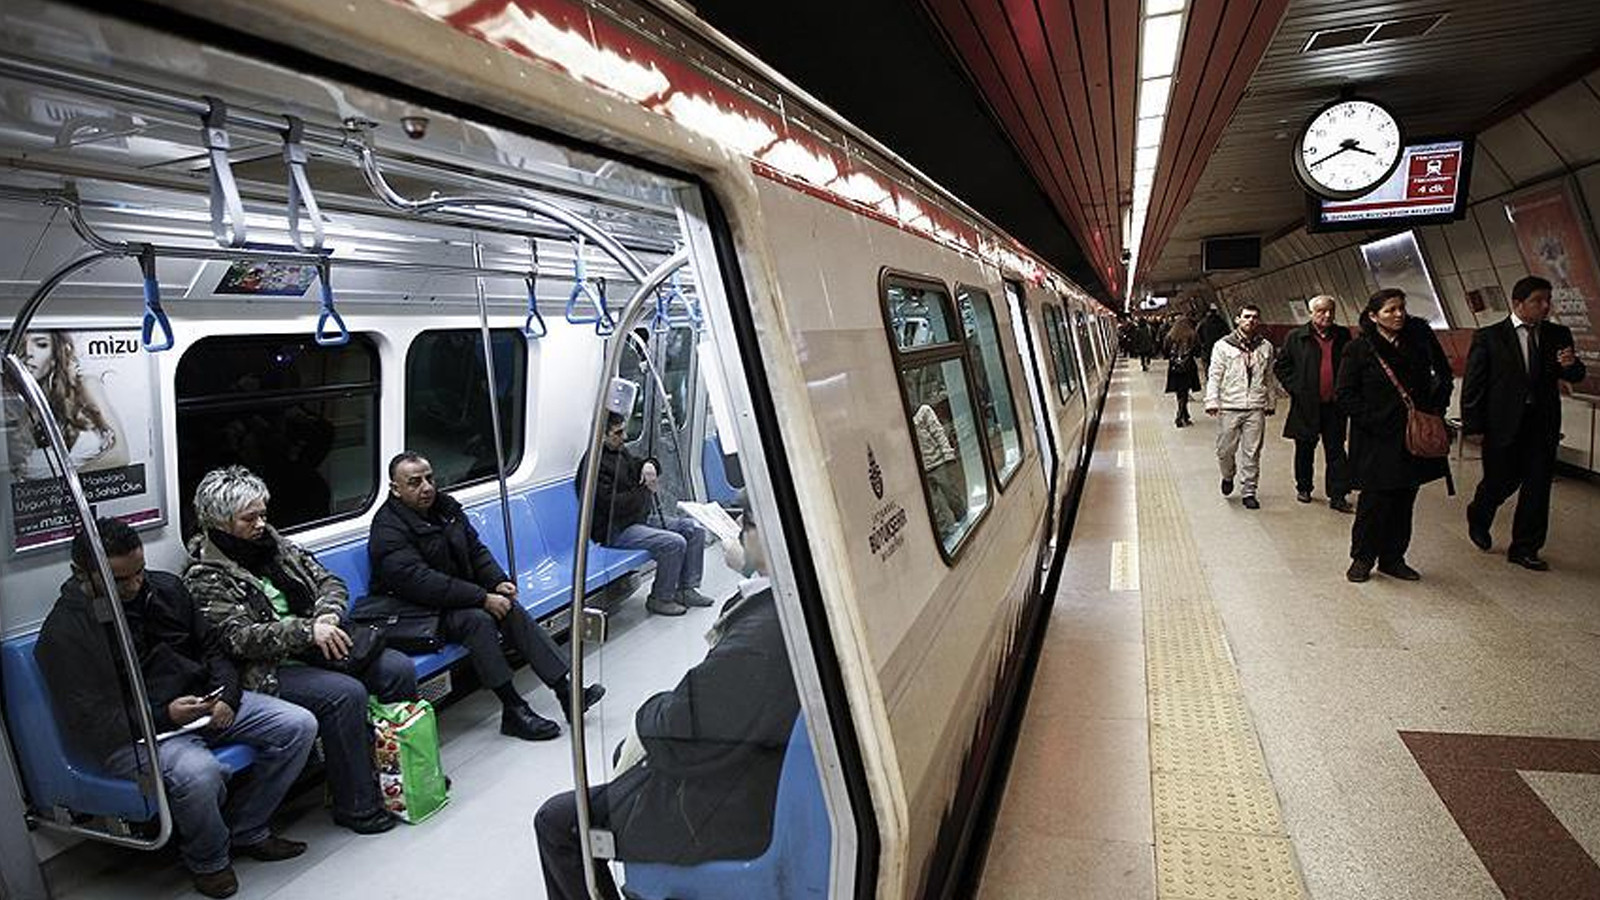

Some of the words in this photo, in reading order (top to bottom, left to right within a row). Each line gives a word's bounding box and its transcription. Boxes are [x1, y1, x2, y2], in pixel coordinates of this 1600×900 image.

[1308, 146, 1318, 155] 9
[1417, 185, 1427, 193] 4
[88, 335, 139, 355] mizu
